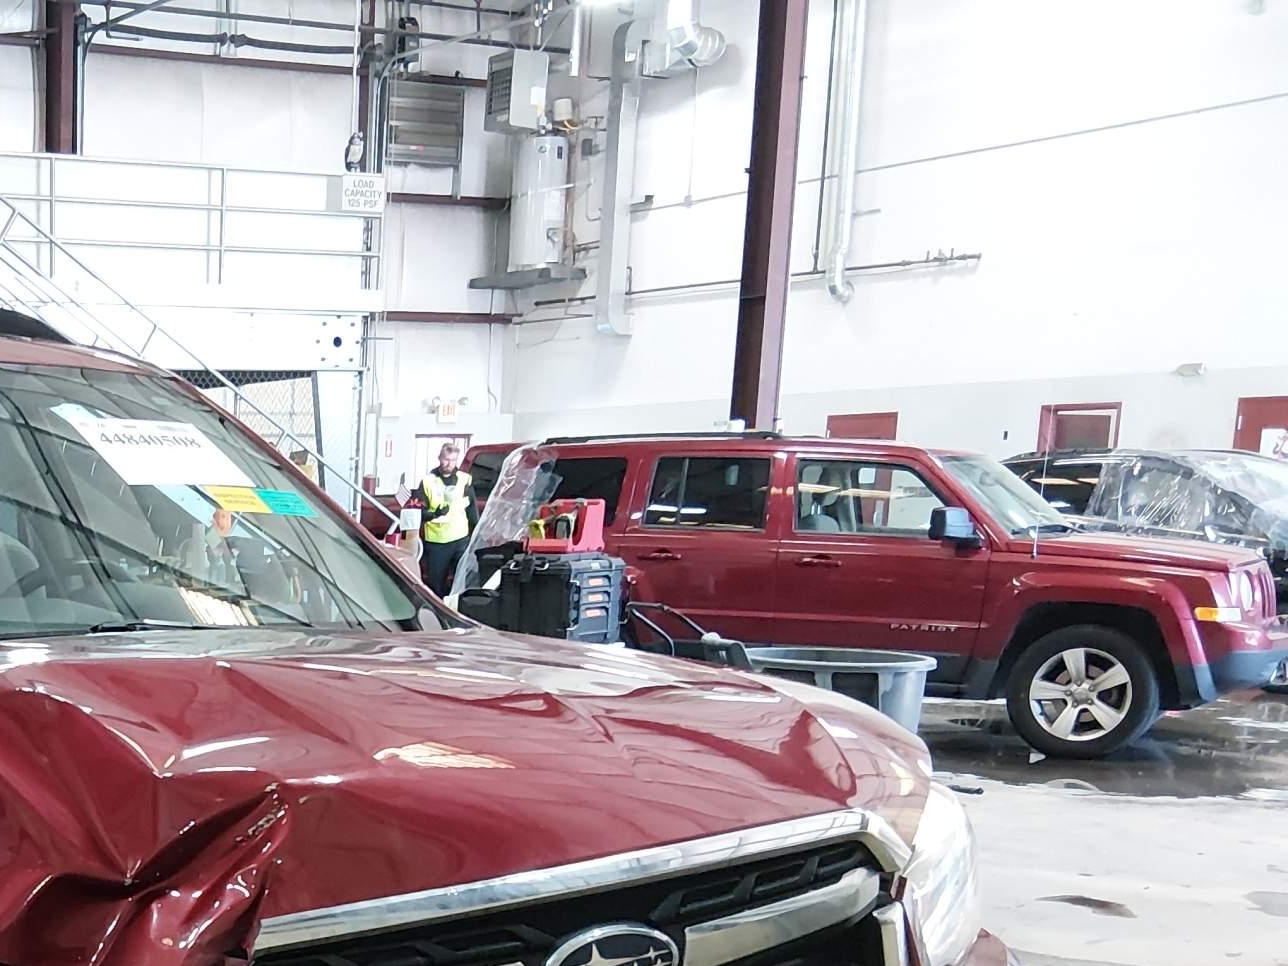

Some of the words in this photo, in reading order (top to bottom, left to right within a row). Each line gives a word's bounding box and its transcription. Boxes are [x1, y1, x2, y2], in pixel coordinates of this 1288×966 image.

[353, 179, 374, 188] LOAD
[344, 188, 382, 199] CAPACITY
[348, 198, 360, 207] 125
[889, 623, 958, 632] PATRIOT
